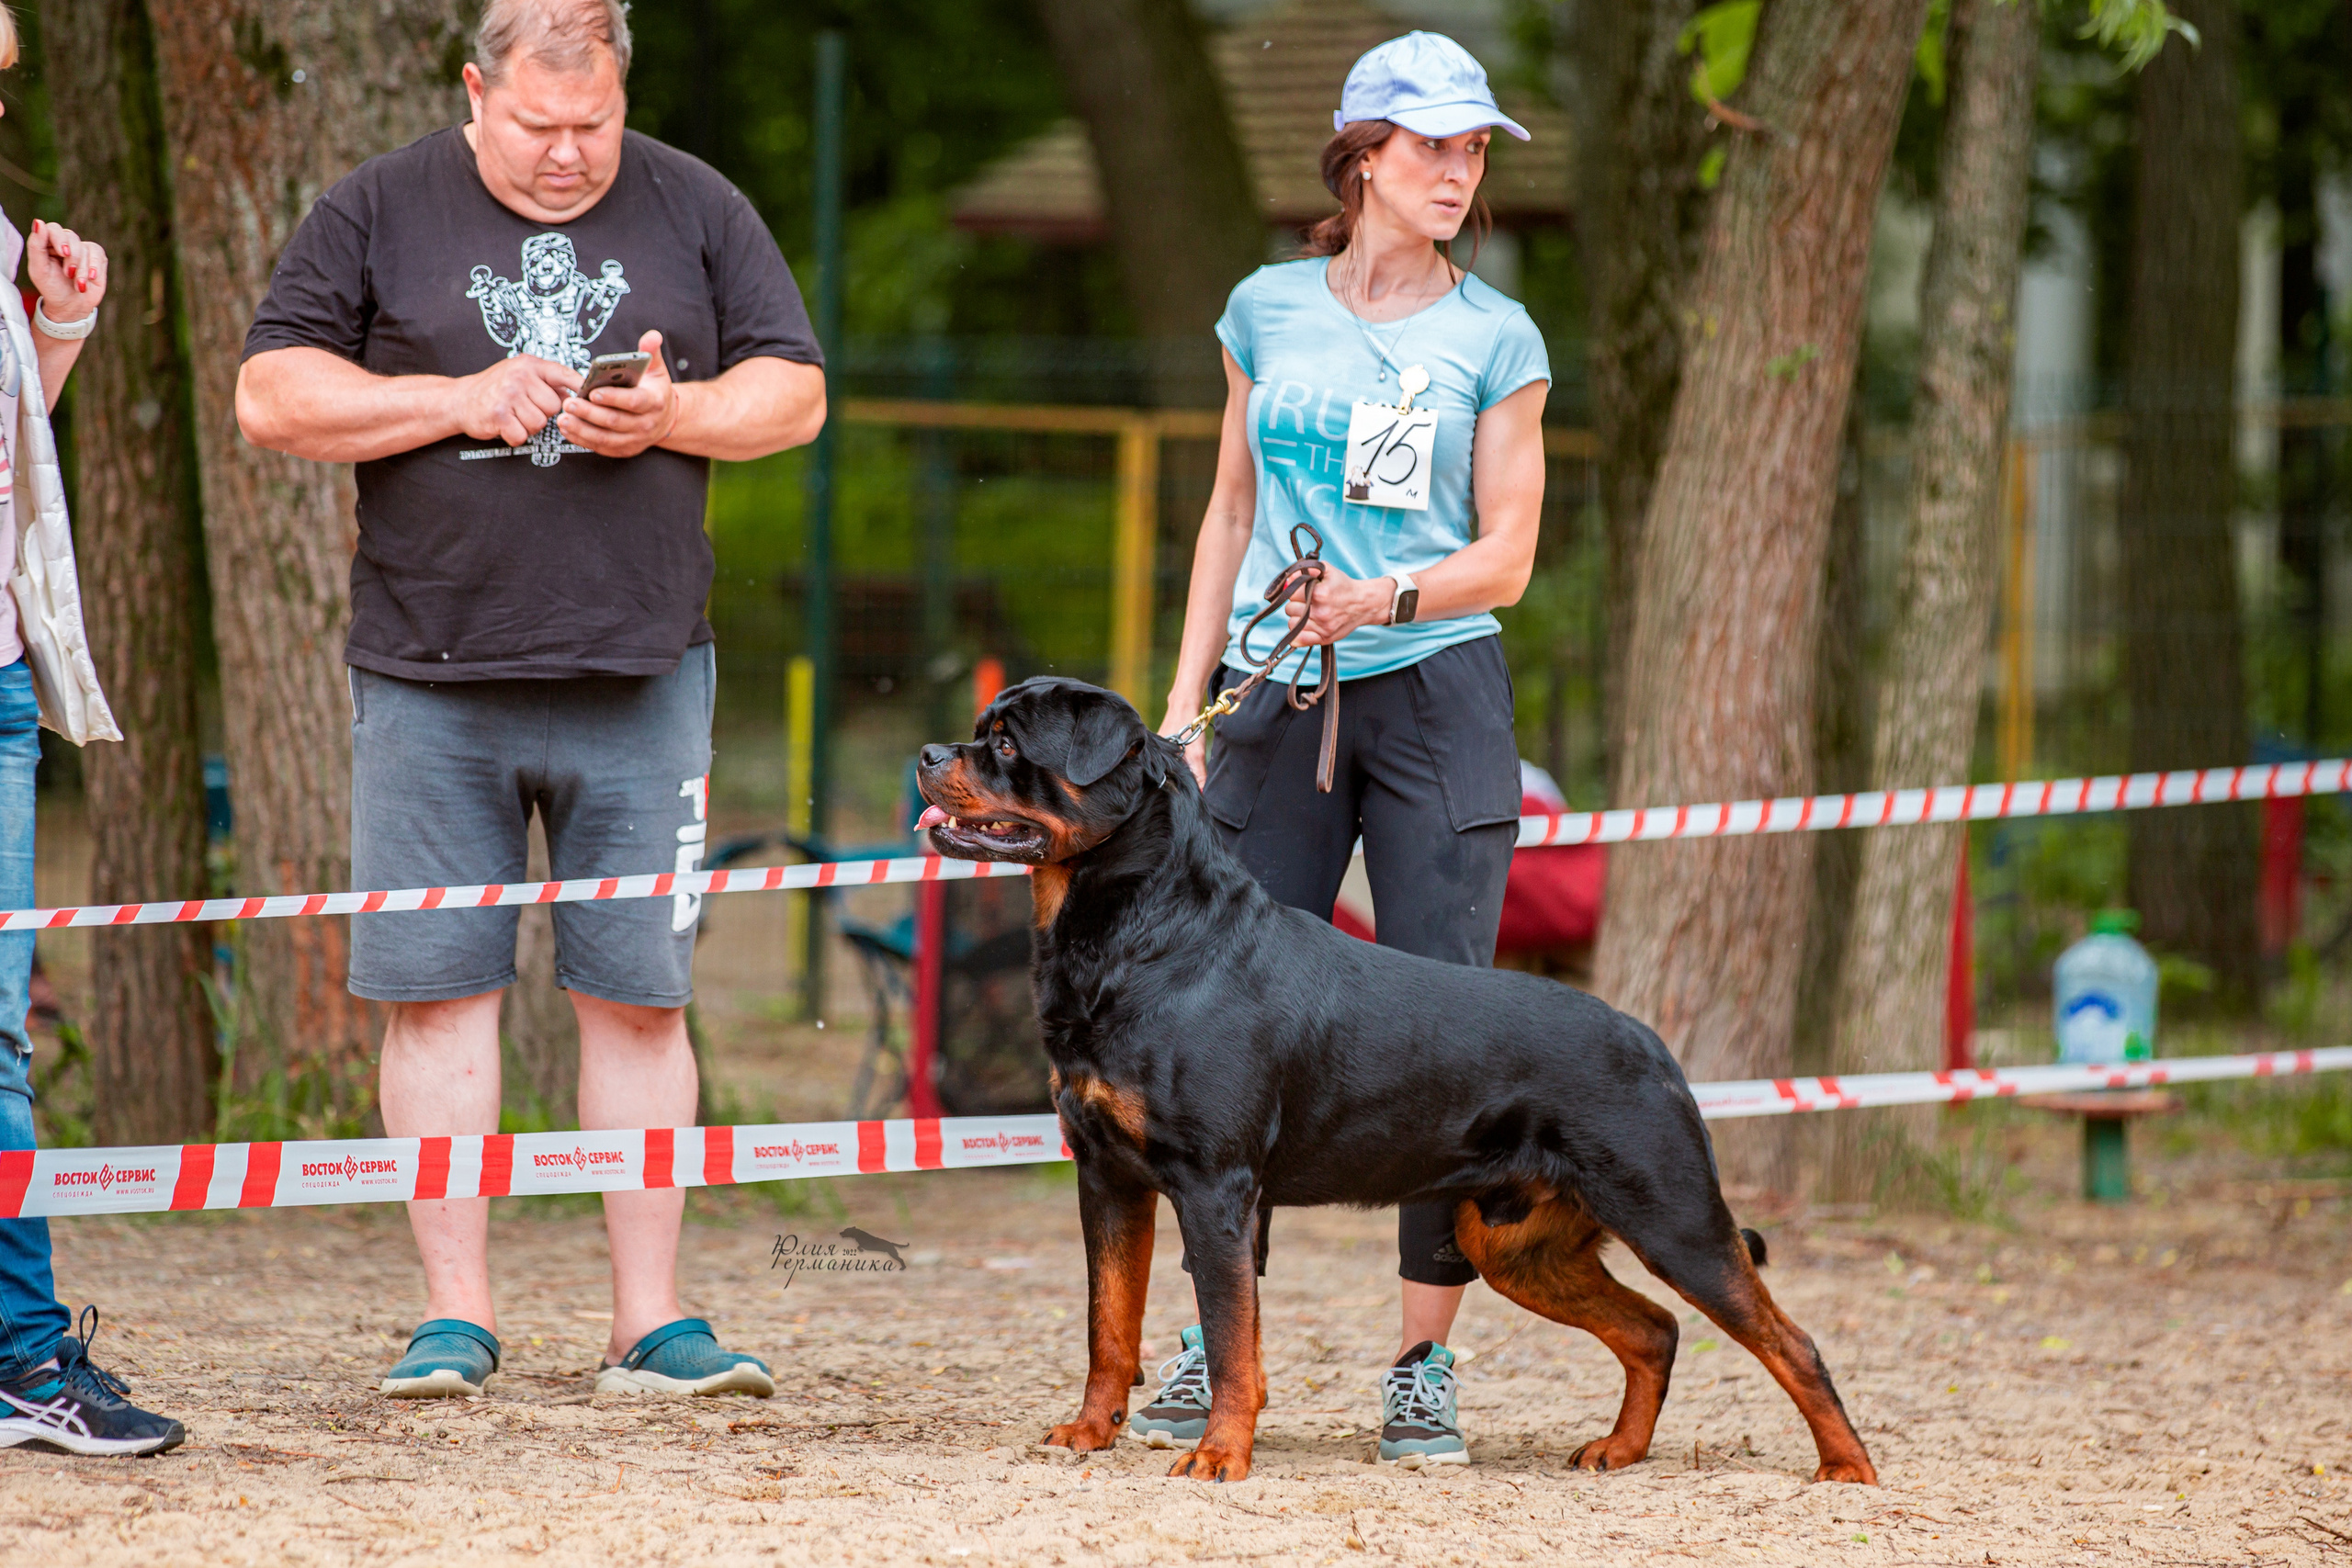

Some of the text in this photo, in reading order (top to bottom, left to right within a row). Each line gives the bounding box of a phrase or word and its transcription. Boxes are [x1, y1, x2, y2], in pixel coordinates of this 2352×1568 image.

[1268, 379, 1351, 442] RU
[1304, 442, 1348, 476] TH
[1360, 419, 1431, 485] 15
[533, 1150, 625, 1167] ВОСТОК СЕРВИС
[753, 1143, 840, 1158] ВОСТОК СЕРВИС
[301, 1159, 398, 1177] ВОСТОК СЕРВИС
[54, 1168, 156, 1186] ВОСТОК СЕРВИС
[301, 1180, 341, 1189] СПЕЦОДЕЖДА
[52, 1190, 94, 1199] СПЕЦОДЕЖДА
[116, 1187, 155, 1195] WWW.VOSTOK.RU
